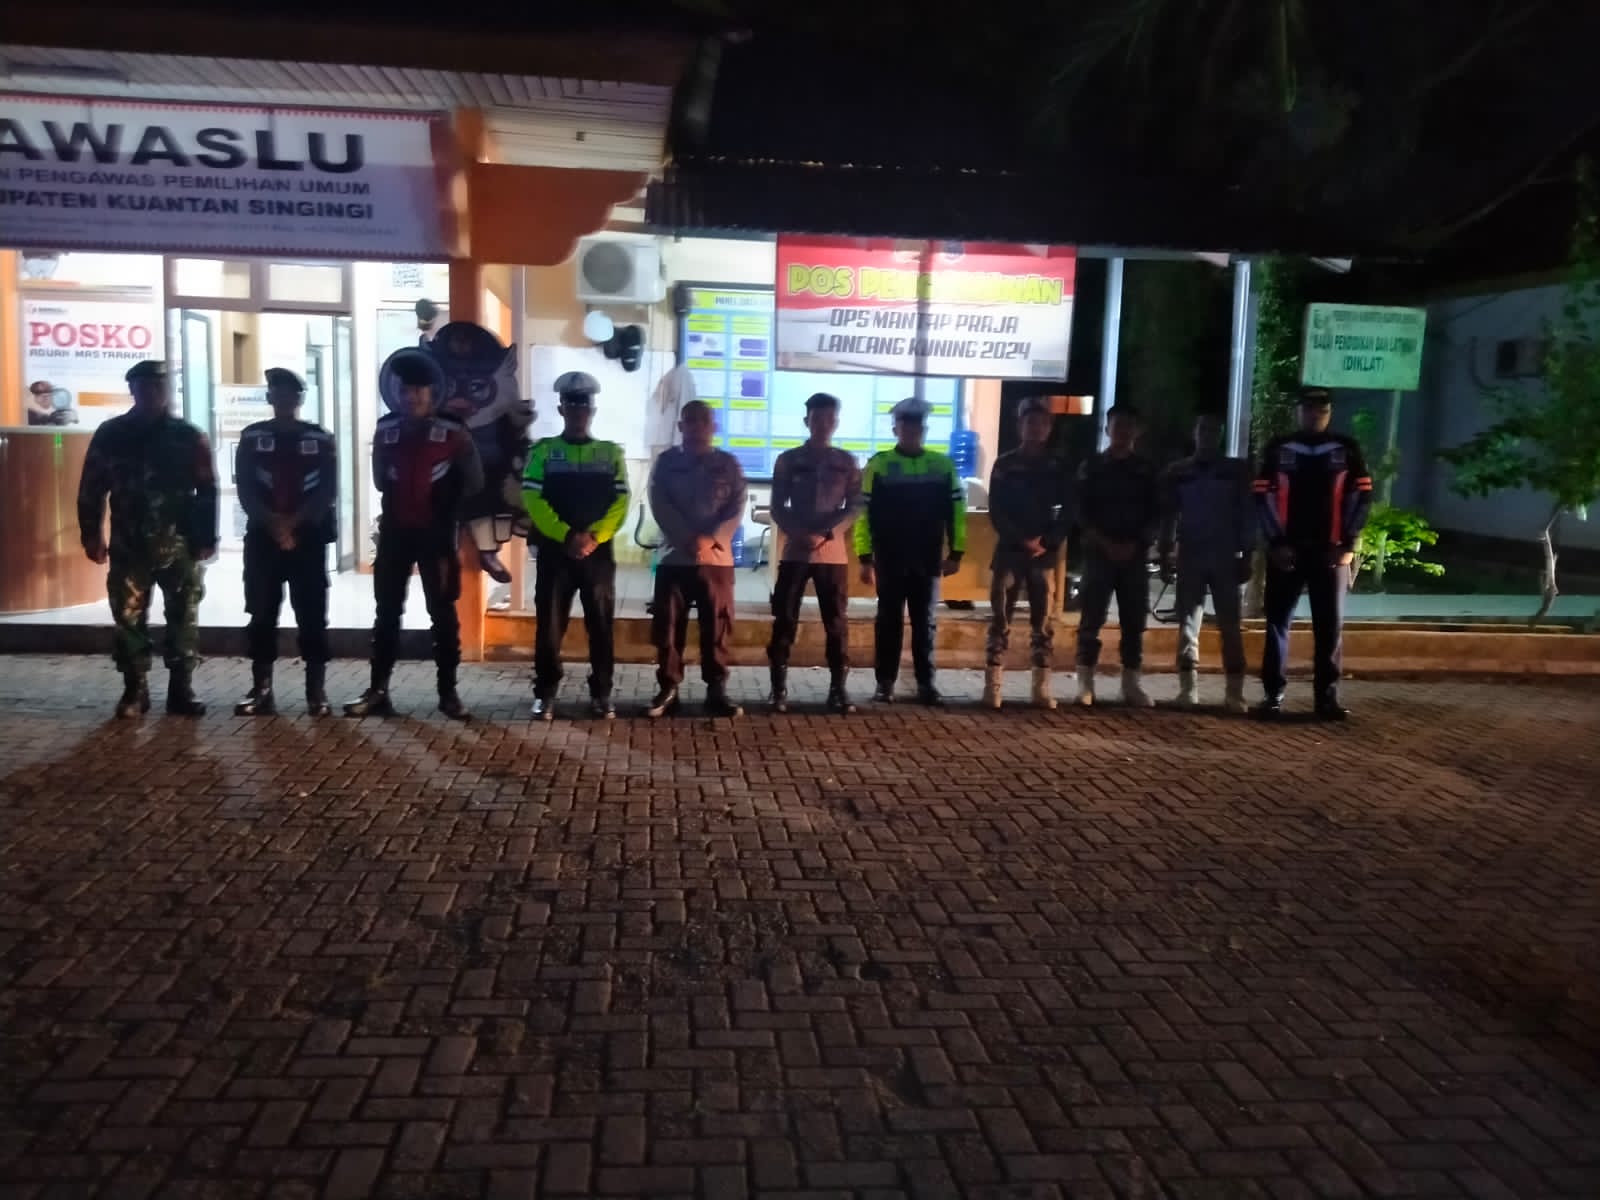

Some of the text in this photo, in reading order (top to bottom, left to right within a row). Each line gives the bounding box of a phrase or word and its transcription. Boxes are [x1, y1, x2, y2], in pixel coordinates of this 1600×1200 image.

[0, 118, 364, 173] AWASLU
[19, 168, 154, 187] PENGAWAS
[163, 175, 290, 192] PEMILIHAN
[299, 179, 371, 195] UMUM
[106, 193, 239, 213] KUANTAN
[248, 199, 374, 220] SINGINGI
[788, 264, 1064, 306] POS PENGAN
[829, 308, 870, 328] OPS
[954, 313, 1020, 334] PRAJA
[29, 321, 152, 350] POSKO
[818, 333, 1032, 360] LANCANG KUNING 2024
